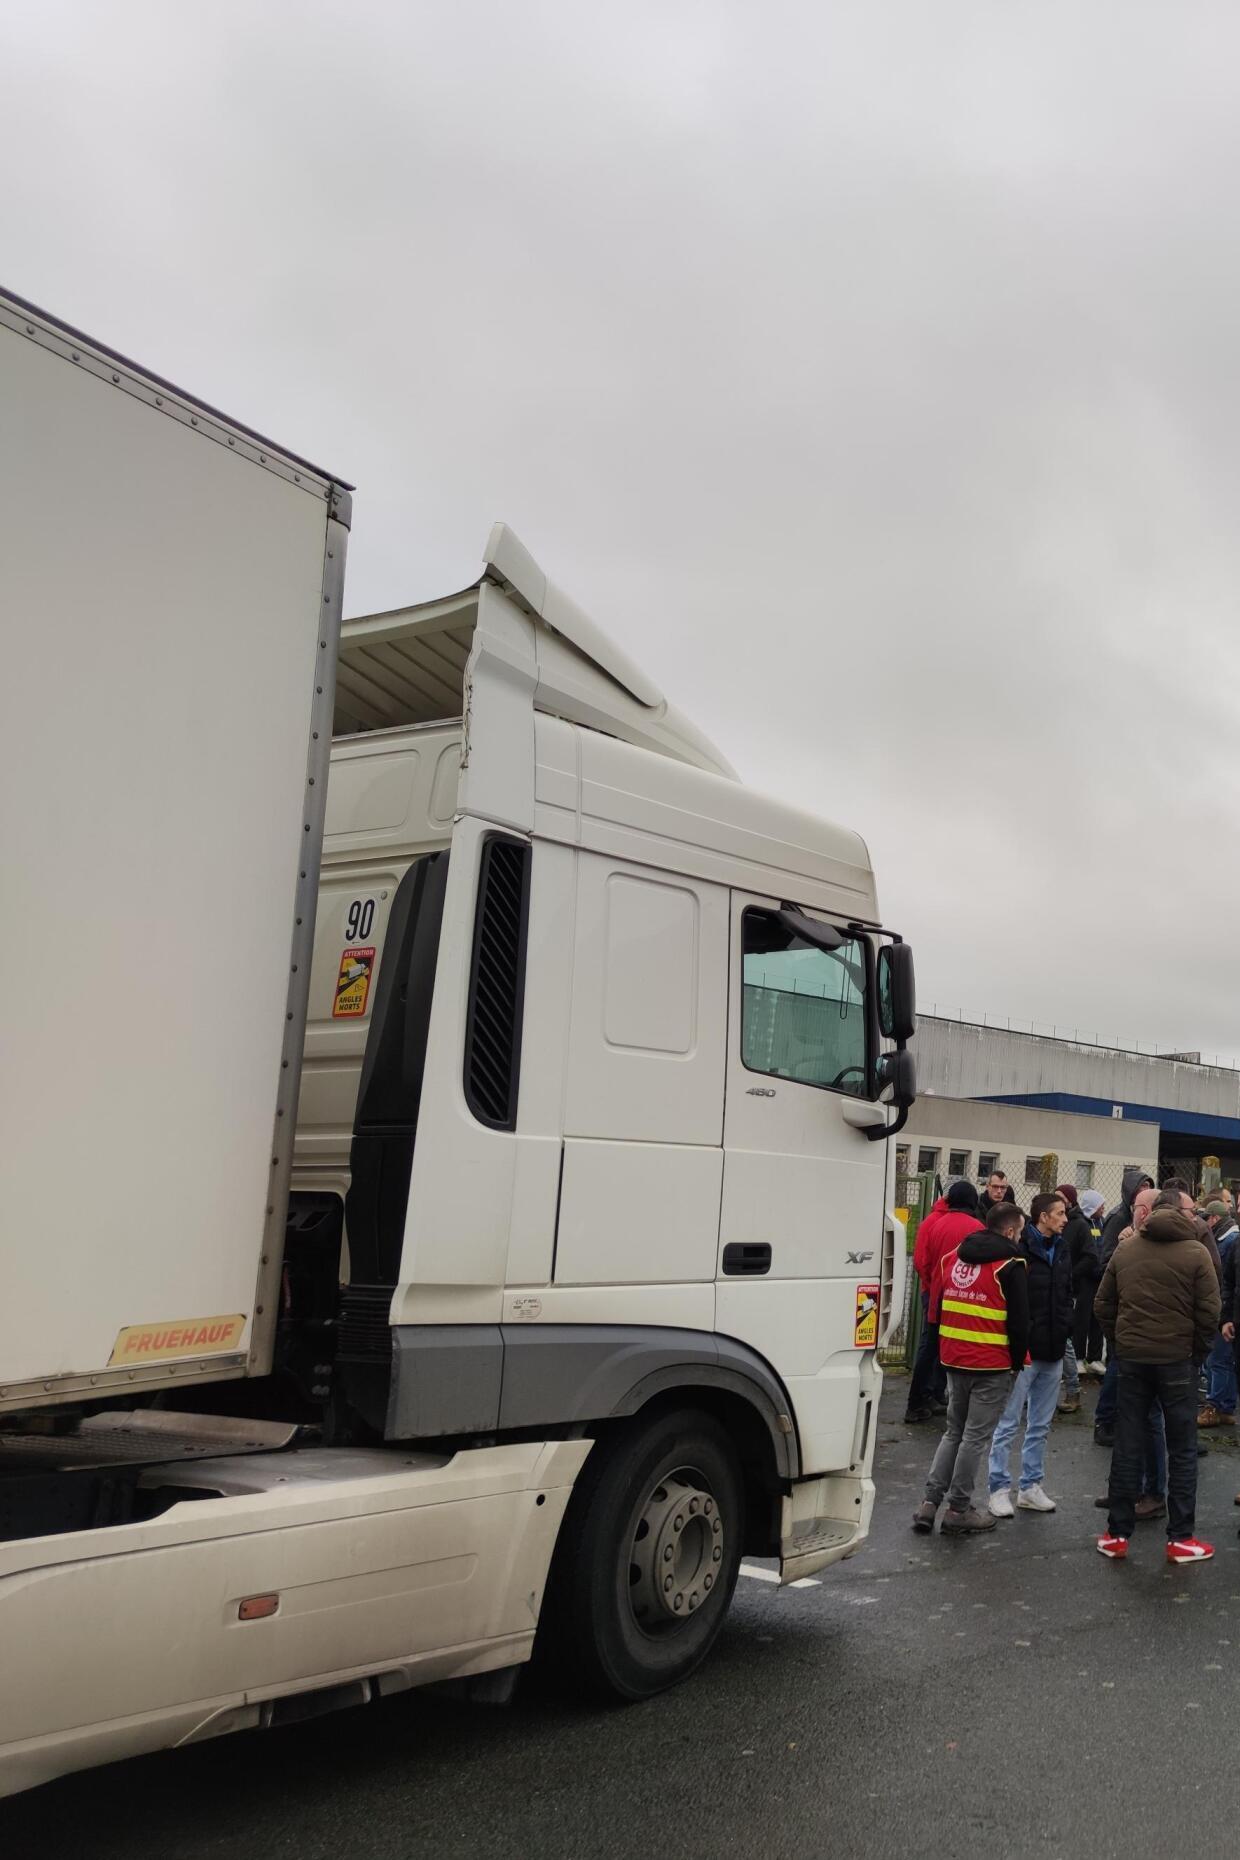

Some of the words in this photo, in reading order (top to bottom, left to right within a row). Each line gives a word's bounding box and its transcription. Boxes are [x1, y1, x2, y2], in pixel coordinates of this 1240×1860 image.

[345, 898, 376, 942] 90
[344, 949, 374, 957] ATTENTION
[338, 995, 362, 1003] ANGLES
[338, 1003, 360, 1011] MORTS
[745, 1088, 776, 1097] 460
[845, 1251, 874, 1264] XF
[955, 1263, 976, 1279] cgt
[123, 1323, 235, 1354] FRUEHAUF
